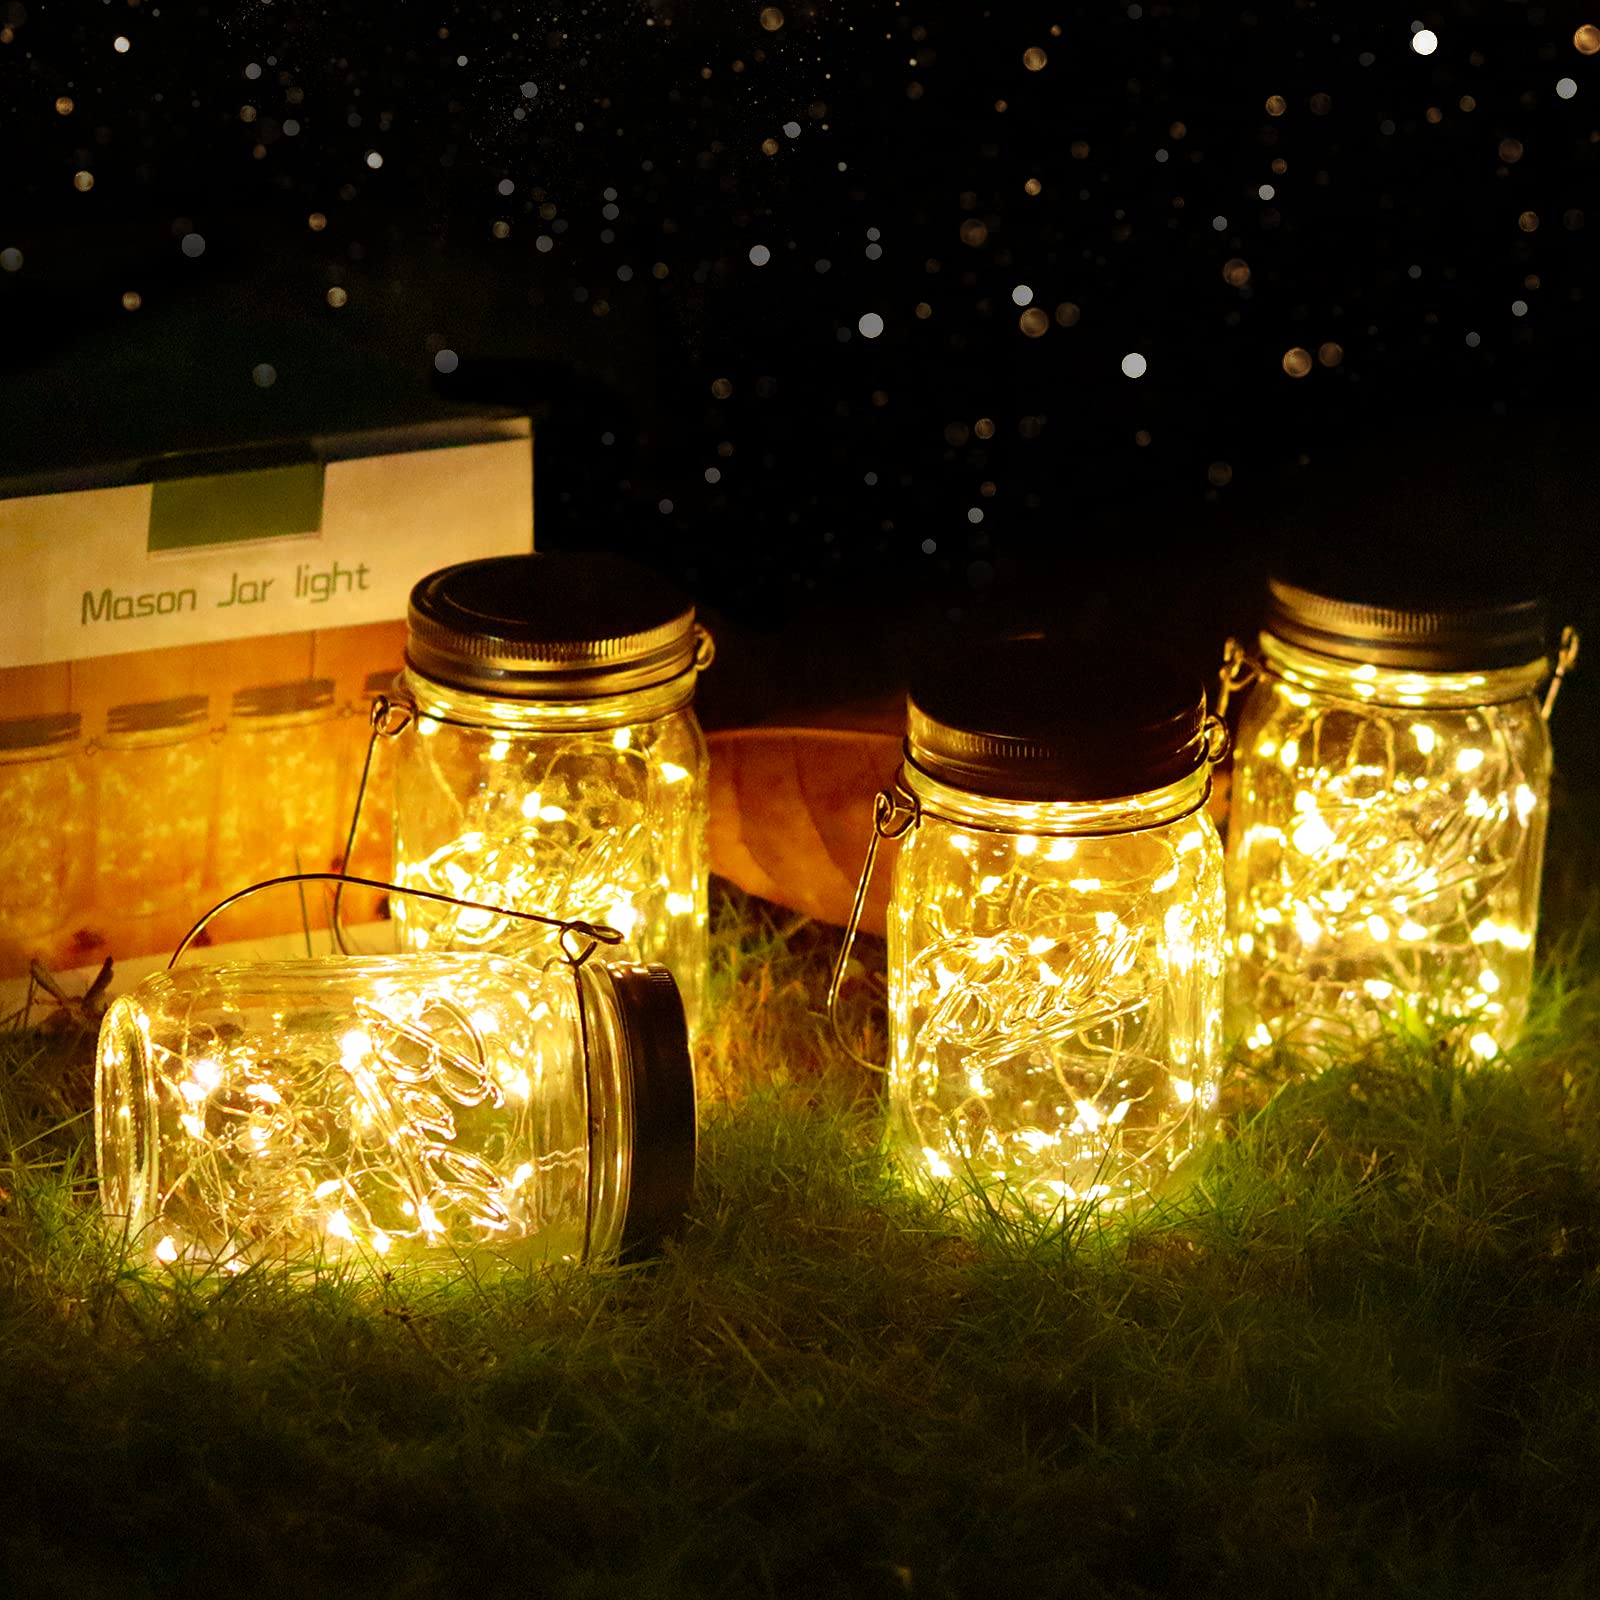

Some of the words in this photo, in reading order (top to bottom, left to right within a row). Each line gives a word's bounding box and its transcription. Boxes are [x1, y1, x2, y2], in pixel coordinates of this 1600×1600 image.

[81, 588, 197, 626] Mason
[216, 571, 275, 609] Jar
[295, 560, 371, 604] light
